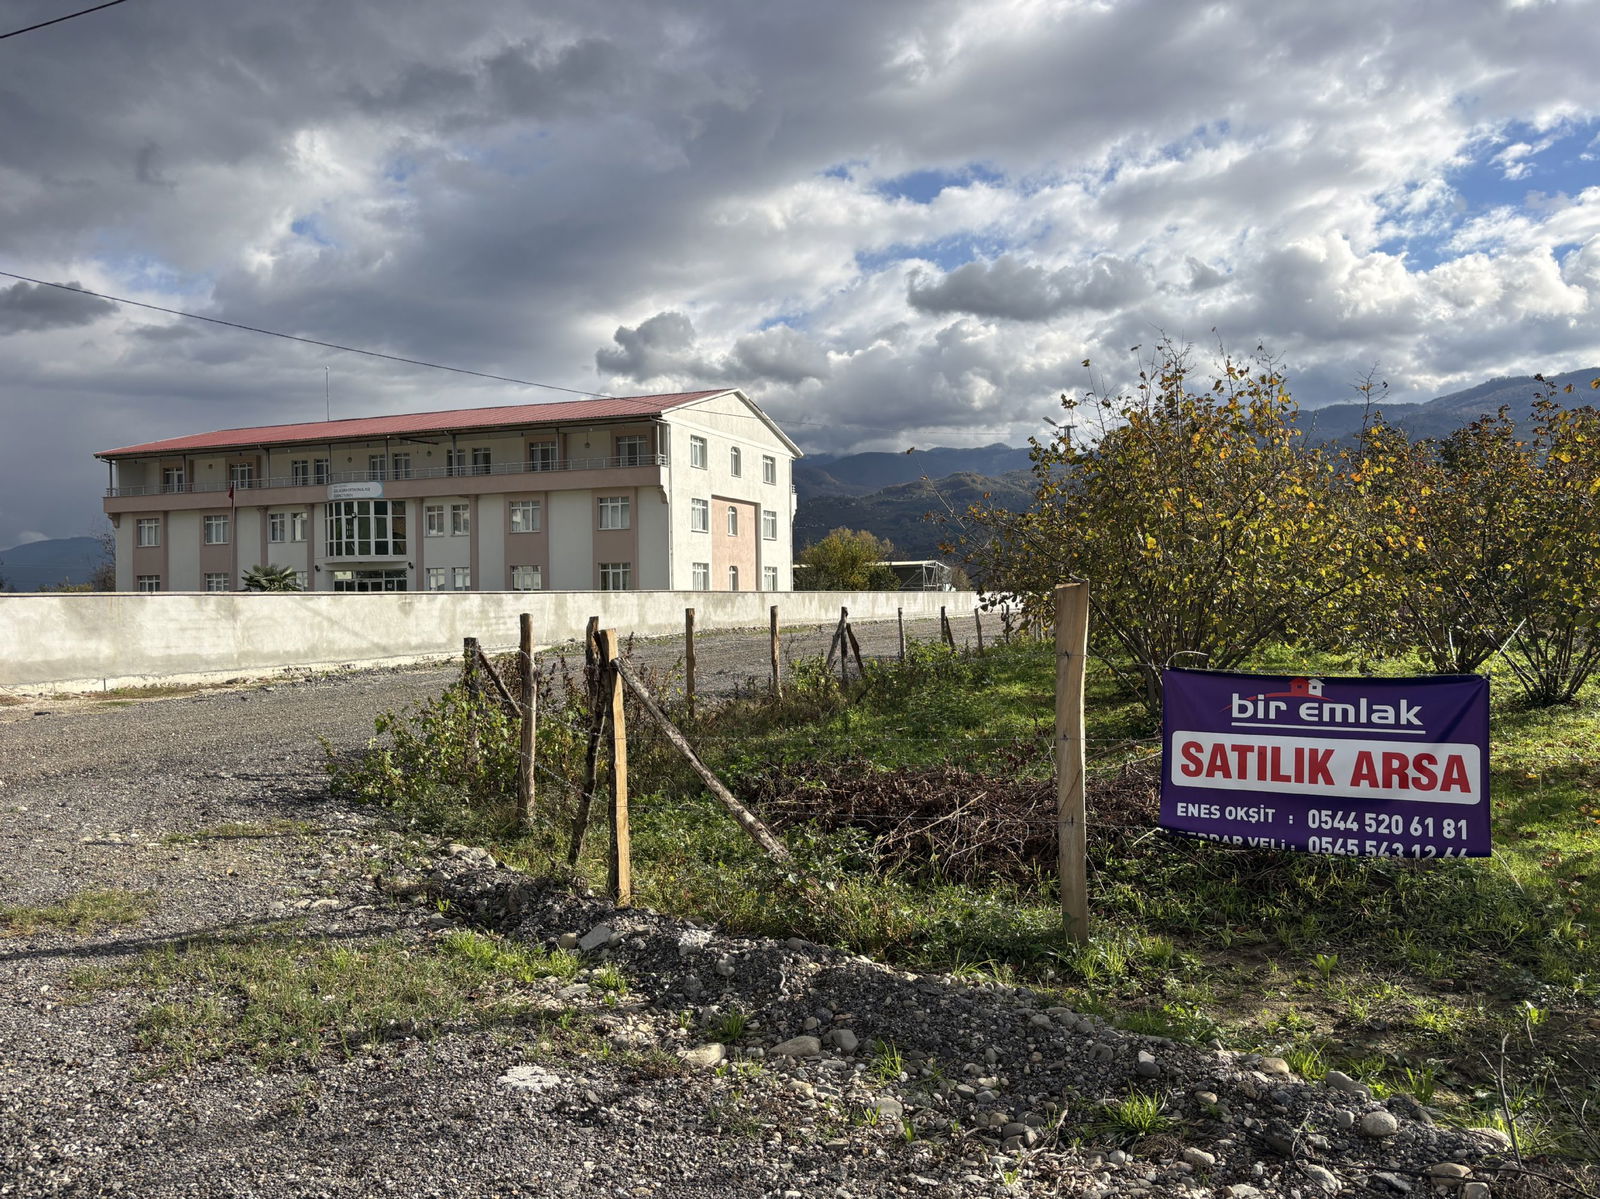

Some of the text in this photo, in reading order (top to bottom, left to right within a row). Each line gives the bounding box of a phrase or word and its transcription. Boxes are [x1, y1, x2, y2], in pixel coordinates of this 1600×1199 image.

[1231, 693, 1424, 726] bir emlak
[1180, 741, 1472, 794] SATILIK ARSA
[1176, 802, 1221, 819] ENES
[1225, 804, 1276, 824] OKŞİT
[1307, 809, 1359, 832] 0544
[1364, 812, 1404, 835] 520
[1409, 816, 1434, 838] 61
[1442, 818, 1468, 841] 81
[1307, 836, 1359, 857] 0545
[1364, 839, 1404, 859] 543
